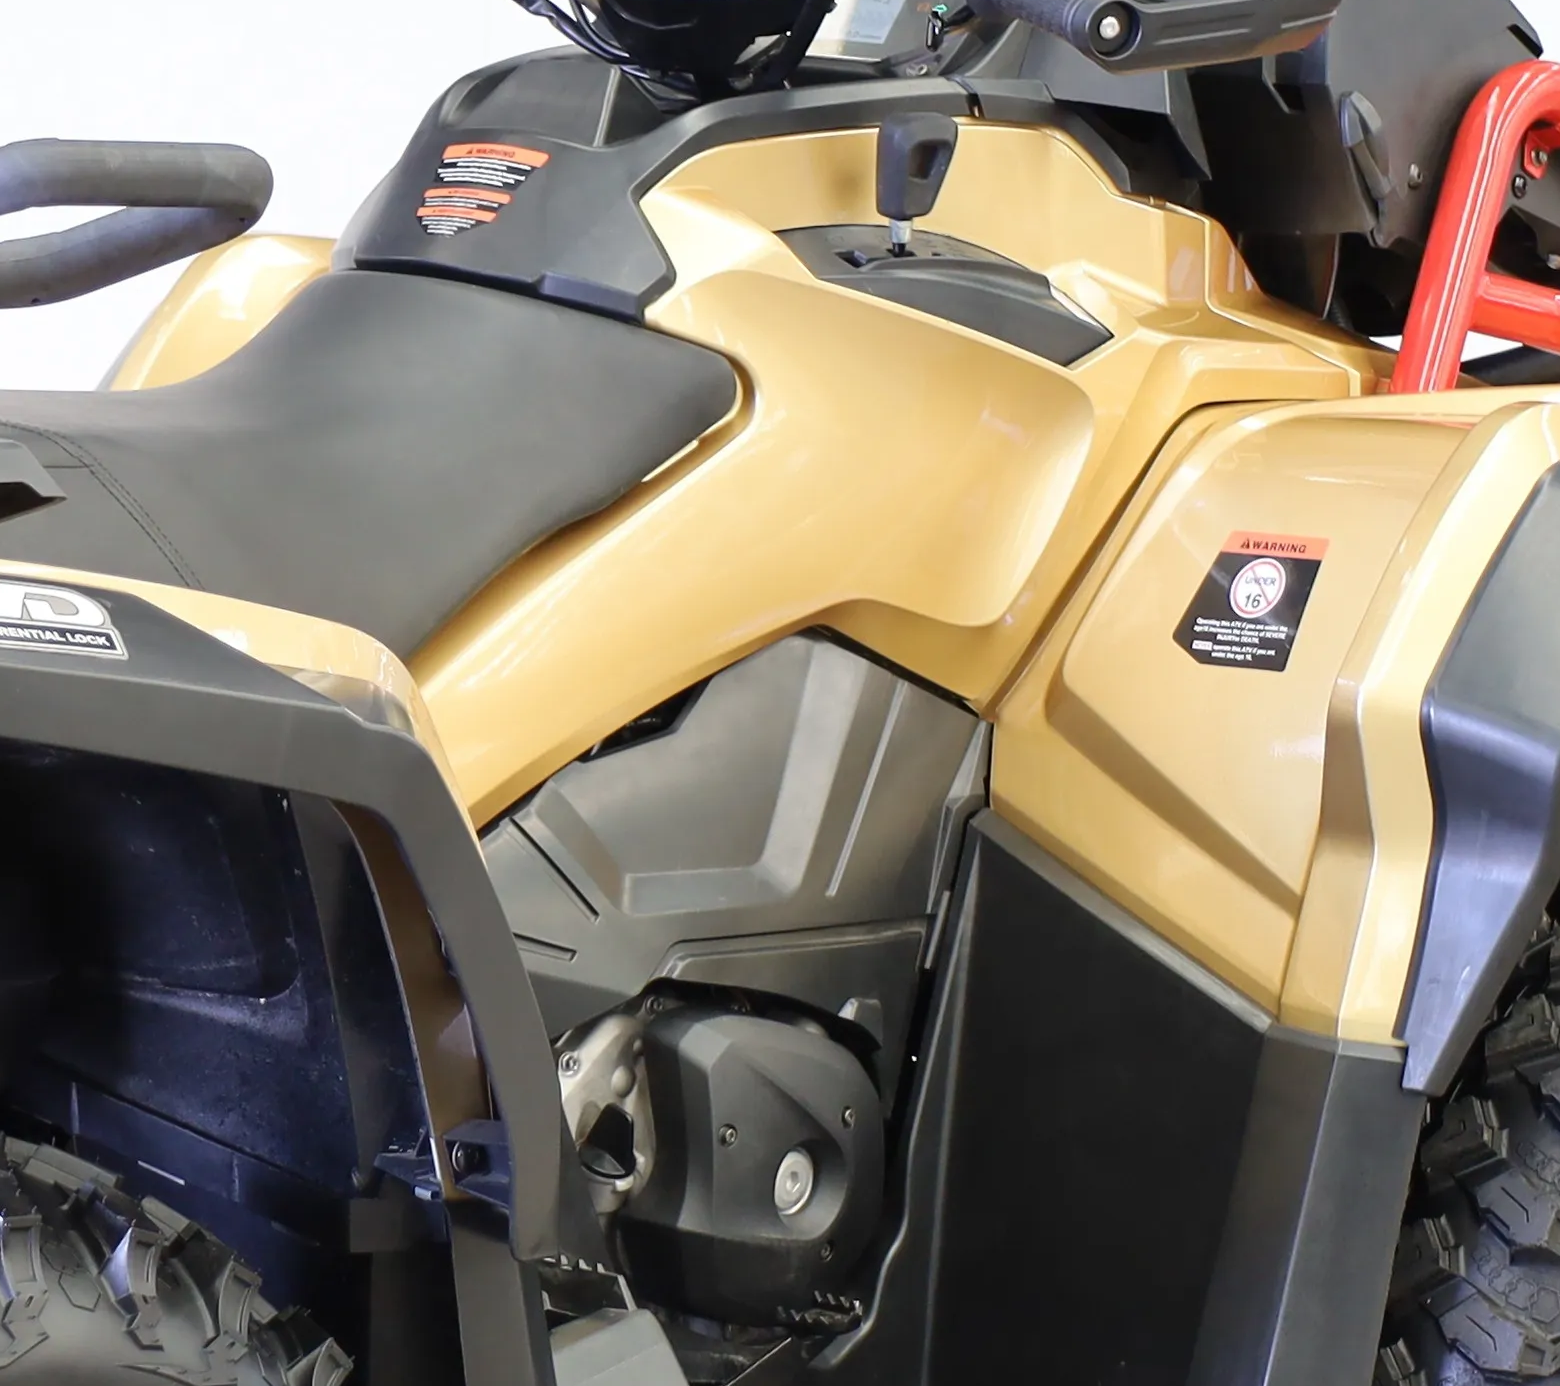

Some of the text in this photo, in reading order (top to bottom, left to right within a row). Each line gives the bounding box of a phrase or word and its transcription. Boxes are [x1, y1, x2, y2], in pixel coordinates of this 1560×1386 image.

[1252, 540, 1307, 554] WARNING
[1244, 575, 1276, 587] UNDER
[1244, 593, 1261, 609] 16
[67, 631, 110, 647] LOCK
